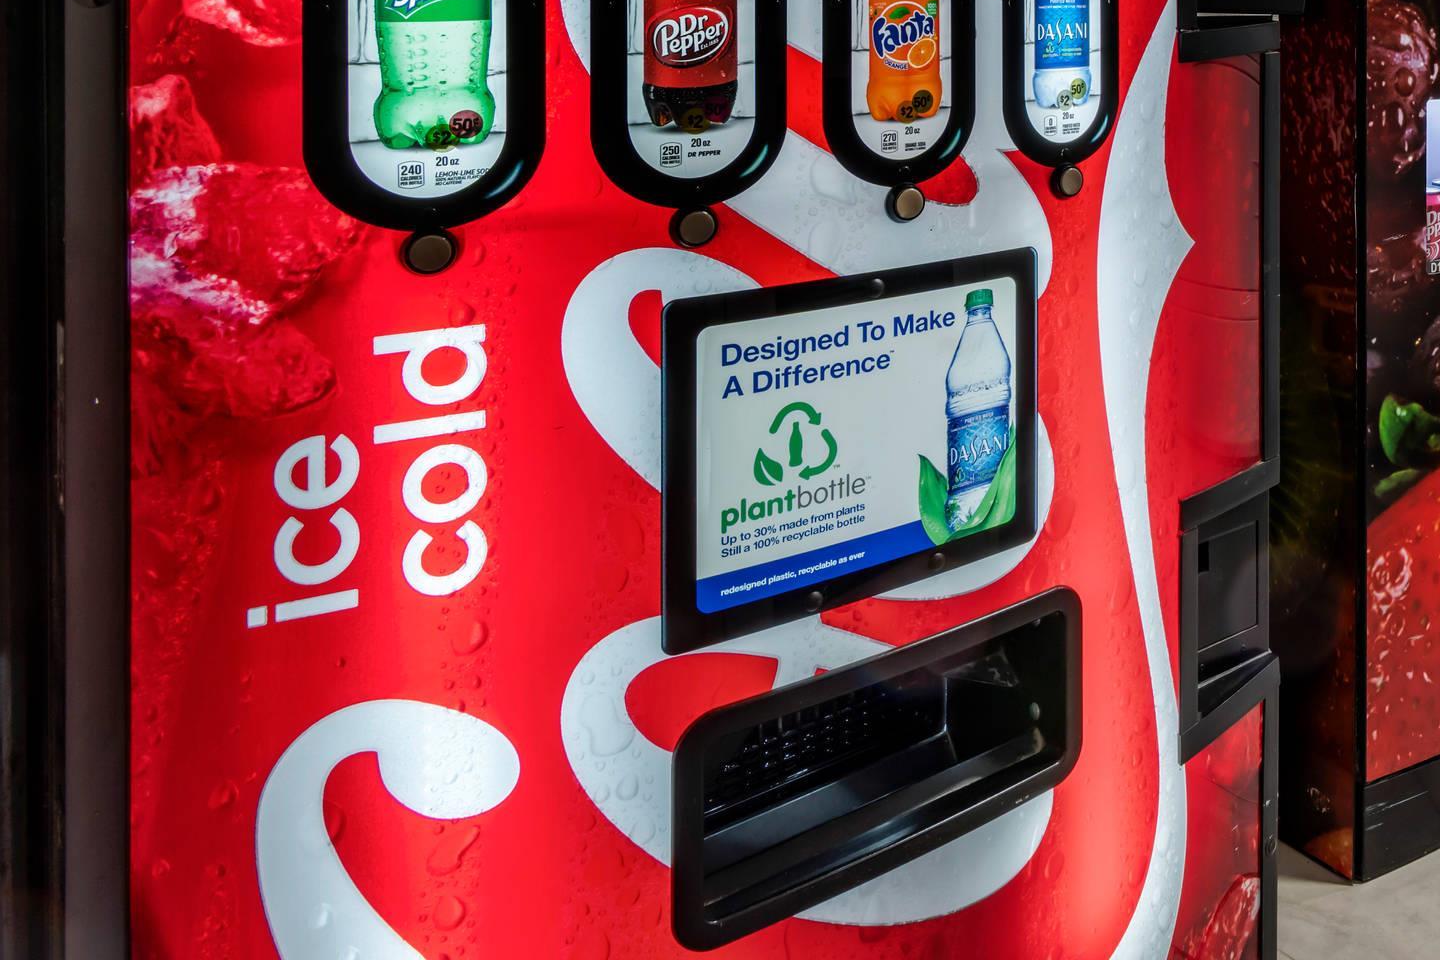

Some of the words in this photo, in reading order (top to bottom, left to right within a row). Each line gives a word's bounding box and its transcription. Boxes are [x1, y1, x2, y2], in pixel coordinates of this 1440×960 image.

[679, 13, 709, 37] Dr
[1037, 17, 1087, 46] DASANI
[656, 19, 725, 57] Pepper
[872, 9, 935, 59] Fanta
[884, 59, 909, 71] ORANGE
[1071, 82, 1085, 95] 50¢
[1059, 95, 1070, 106] $2
[900, 105, 914, 119] $2
[1062, 111, 1070, 120] 20
[452, 117, 480, 132] 50¢
[904, 126, 914, 135] 20
[432, 130, 452, 145] $2
[690, 137, 702, 148] 20
[882, 132, 897, 143] 270
[662, 145, 680, 156] 250
[697, 149, 721, 157] PEPPER
[435, 155, 448, 167] 20
[400, 164, 422, 176] 240
[435, 169, 476, 178] LEMON-LIME
[1430, 262, 1440, 273] D1
[721, 325, 849, 367] Designed
[856, 320, 886, 343] To
[893, 310, 956, 337] Make
[721, 375, 745, 400] A
[752, 351, 892, 394] Difference
[950, 433, 1007, 465] DASANI
[372, 323, 489, 597] cold
[721, 473, 867, 535] plantbottle
[246, 433, 361, 629] ice
[721, 535, 737, 547] Up
[740, 532, 751, 542] to
[754, 524, 777, 538] 30%
[779, 517, 809, 532] made
[810, 511, 834, 524] from
[835, 503, 866, 518] plants
[721, 545, 742, 559] Still
[743, 545, 751, 553] a
[753, 538, 780, 551] 100%
[782, 523, 835, 544] recyclable
[836, 514, 866, 529] bottle
[720, 578, 767, 597] redesigned
[768, 570, 797, 586] plastic,
[798, 559, 838, 578] recyclable
[838, 557, 848, 565] as
[848, 551, 866, 562] ever
